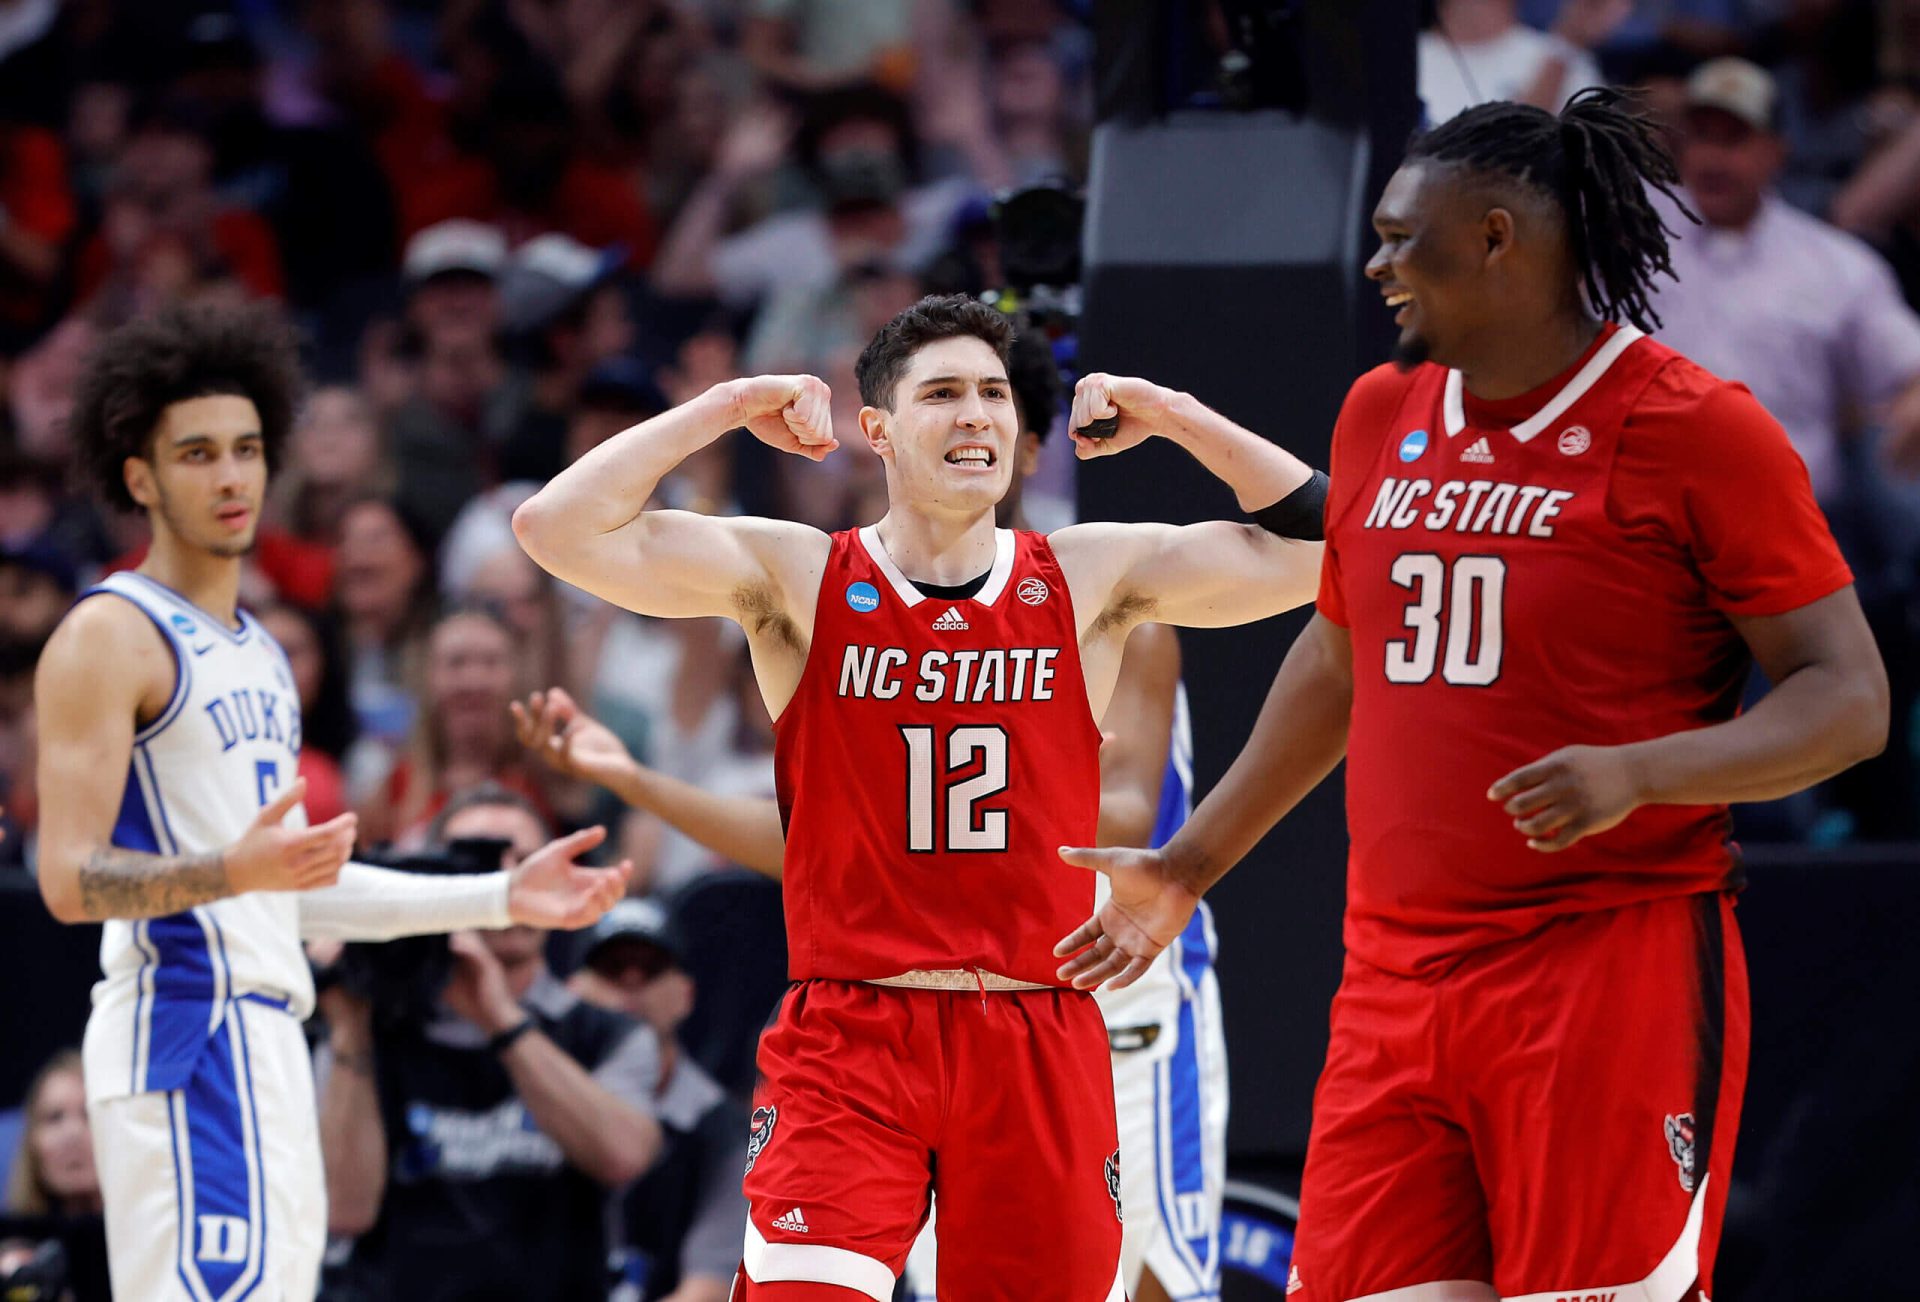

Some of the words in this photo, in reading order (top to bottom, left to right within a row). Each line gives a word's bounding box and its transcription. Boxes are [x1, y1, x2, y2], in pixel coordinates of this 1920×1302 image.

[1363, 477, 1432, 530] NC
[1424, 479, 1576, 538] STATE
[850, 594, 878, 606] NCAA
[1020, 586, 1047, 596] ACC
[932, 620, 969, 631] adidas
[1384, 552, 1507, 687] 30
[837, 644, 908, 700] NC
[915, 647, 1061, 703] STATE
[897, 723, 1009, 853] 12
[197, 1214, 249, 1262] D
[771, 1219, 809, 1233] adidas
